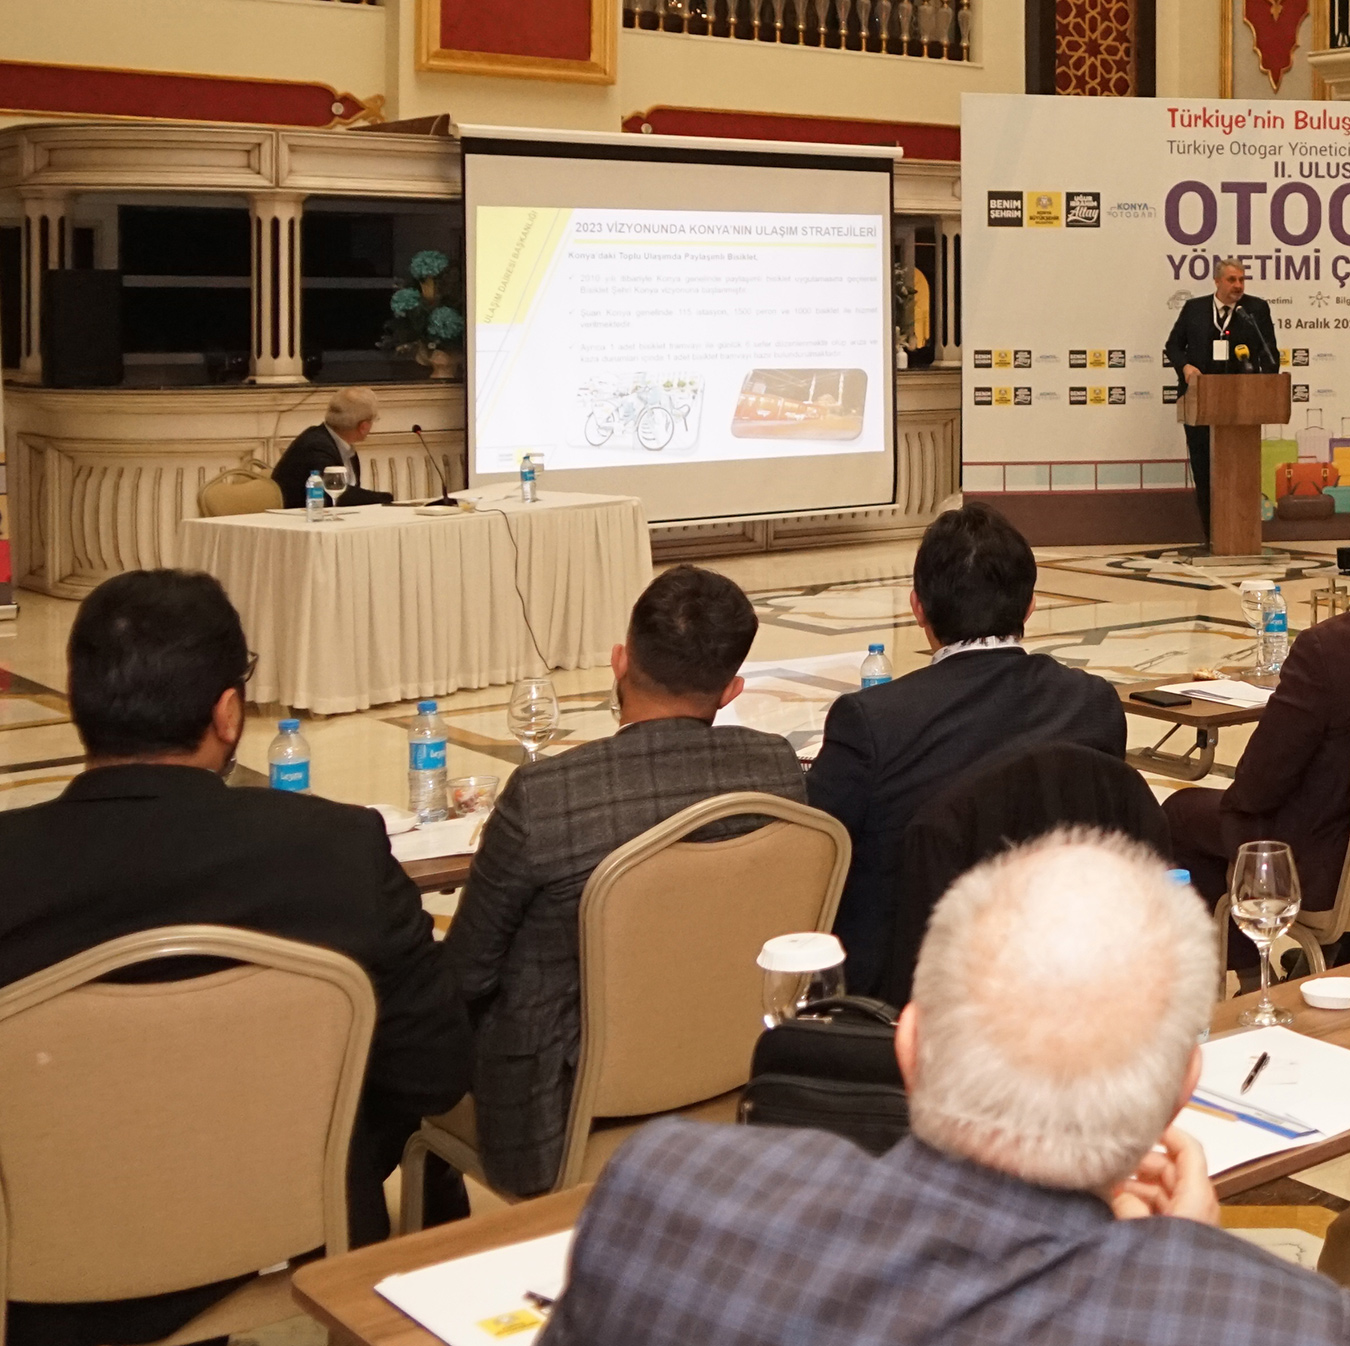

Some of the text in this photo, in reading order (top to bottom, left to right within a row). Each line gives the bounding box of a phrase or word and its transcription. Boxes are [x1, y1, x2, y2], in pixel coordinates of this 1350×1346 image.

[1167, 107, 1285, 135] Türkiye'nin
[1166, 140, 1225, 157] Türkiye
[1229, 141, 1283, 159] Otogar
[1274, 161, 1293, 179] II.
[1117, 202, 1149, 210] KONYA
[575, 220, 877, 238] 2023 VİZYONUNDA KONYA'NIN ULAŞIM STRATEJİLERİ
[1166, 249, 1321, 281] YÖETİMİ
[1295, 317, 1330, 330] Aralık
